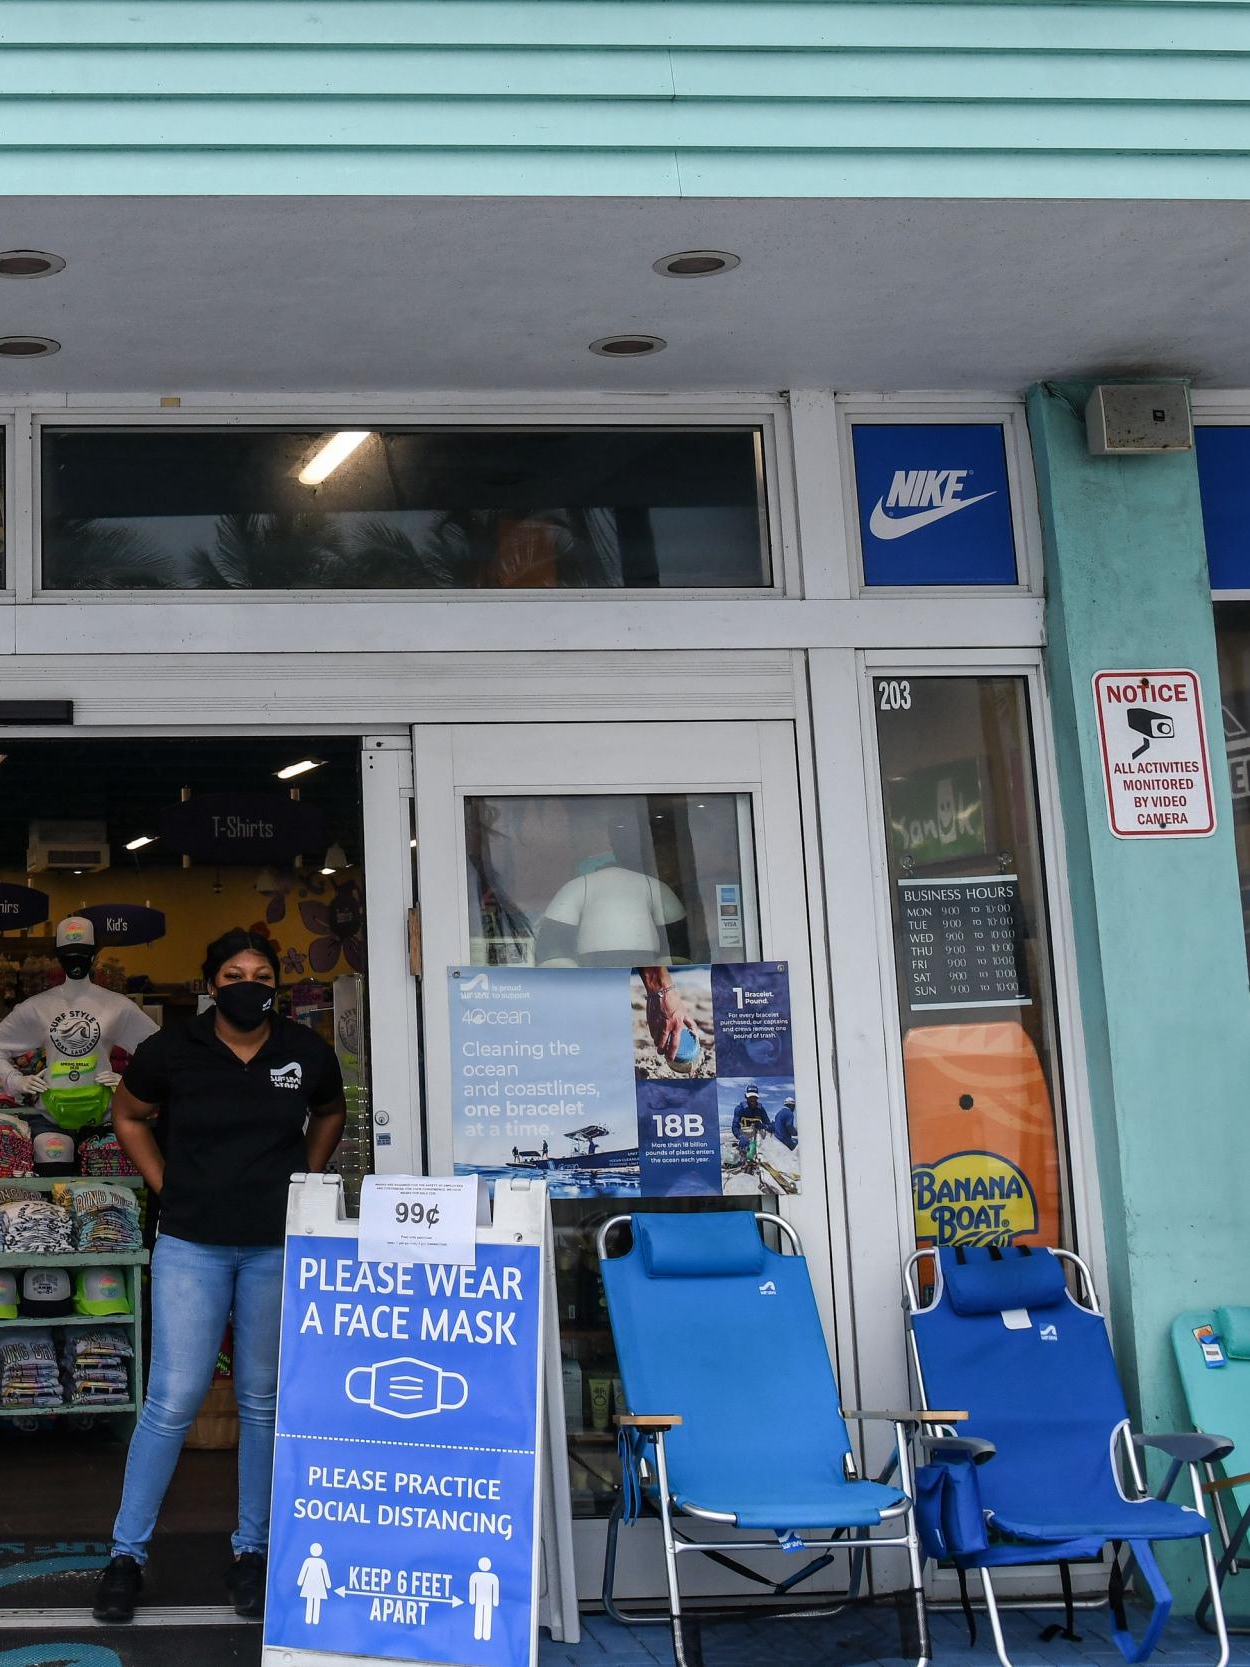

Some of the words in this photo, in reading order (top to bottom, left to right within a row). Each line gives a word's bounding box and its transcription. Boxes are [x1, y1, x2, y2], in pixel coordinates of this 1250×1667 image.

[886, 470, 967, 507] NIKE
[878, 680, 912, 711] 203
[1106, 684, 1188, 703] NOTICE
[1114, 762, 1135, 774] ALL
[1137, 761, 1199, 774] ACTIVITIES
[1123, 778, 1194, 791] MONITORED
[1134, 796, 1149, 808] BY
[1151, 795, 1187, 807] VIDEO
[211, 816, 274, 838] T-Shirts
[1137, 813, 1188, 825] CAMERA
[904, 889, 961, 902] BUSINESS
[966, 886, 1014, 899] HOURS
[907, 908, 932, 917] MON
[106, 917, 128, 931] Kid's
[908, 920, 928, 930] TUE
[910, 934, 934, 943] WED
[911, 946, 933, 956] THU
[912, 960, 928, 969] FRI
[914, 973, 931, 982] SAT
[733, 987, 743, 1009] 1
[915, 986, 937, 996] SUN
[50, 1012, 67, 1033] SURF
[69, 1010, 97, 1024] STYLE
[462, 1041, 543, 1059] Cleaning
[549, 1040, 581, 1056] the
[463, 1063, 518, 1077] ocean
[464, 1081, 499, 1097] and
[504, 1080, 600, 1099] coastlines,
[465, 1102, 500, 1117] one
[506, 1100, 584, 1117] bracelet
[466, 1123, 484, 1137] at
[490, 1125, 500, 1137] a
[505, 1120, 554, 1137] time.
[652, 1114, 705, 1137] 18B
[912, 1171, 1023, 1210] BANANA
[395, 1202, 440, 1229] 99¢
[931, 1204, 1006, 1246] BOAT
[300, 1257, 414, 1296] PLEASE
[425, 1264, 522, 1300] WEAR
[300, 1302, 323, 1335] A
[334, 1303, 409, 1340] FACE
[421, 1307, 518, 1346] MASK
[308, 1466, 387, 1492] PLEASE
[395, 1472, 501, 1500] PRACTICE
[294, 1498, 370, 1524] SOCIAL
[378, 1505, 512, 1540] DISTANCING
[349, 1566, 391, 1591] KEEP
[397, 1570, 408, 1594] 6
[411, 1571, 452, 1598] FEET
[370, 1598, 429, 1625] APART
